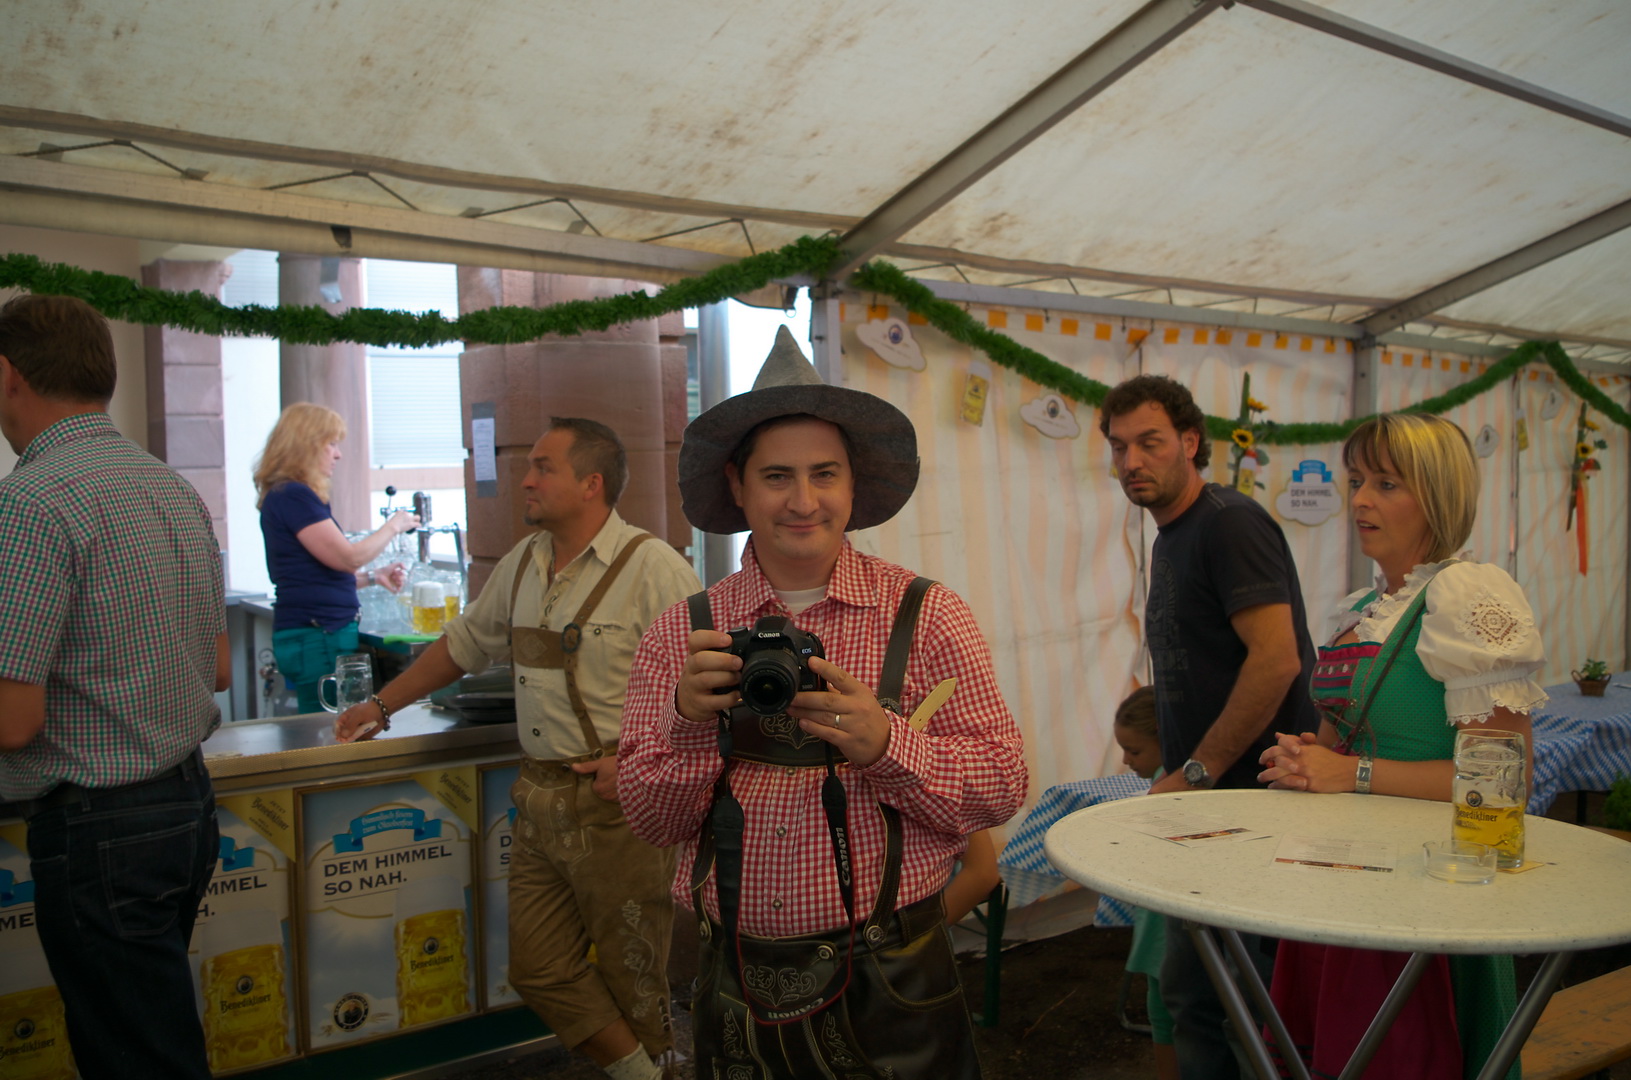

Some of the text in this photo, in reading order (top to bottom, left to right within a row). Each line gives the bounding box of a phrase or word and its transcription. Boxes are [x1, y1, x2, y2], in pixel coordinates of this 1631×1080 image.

[1291, 489, 1305, 497] DEM
[251, 797, 289, 830] Benediktiner
[324, 845, 453, 877] DEM HIMMEL
[500, 853, 511, 865] S
[835, 827, 851, 887] Canon
[205, 876, 267, 896] MMEL
[324, 871, 407, 896] SO NAH.
[410, 955, 454, 971] Benediktiner
[220, 994, 271, 1013] Benediktiner
